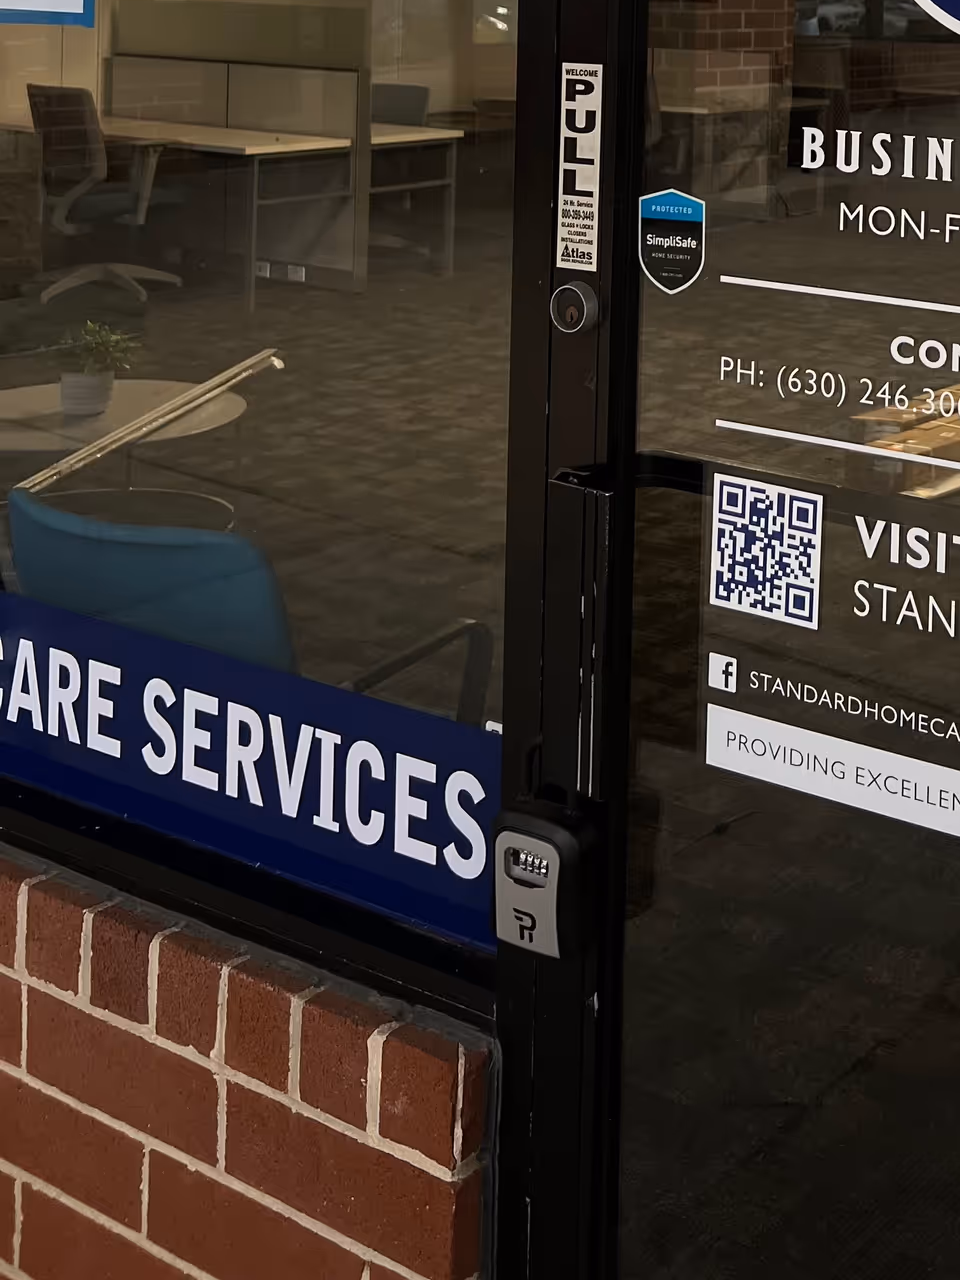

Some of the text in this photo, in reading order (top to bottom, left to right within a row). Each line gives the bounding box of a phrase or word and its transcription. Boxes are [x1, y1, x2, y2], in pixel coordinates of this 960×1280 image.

[565, 68, 599, 77] WELCOME
[562, 78, 596, 198] PULL
[652, 205, 693, 215] PROTECTED
[560, 237, 593, 245] INSTALLATIONS
[646, 233, 697, 248] SimpliSafe
[560, 243, 592, 260] Atlas
[720, 356, 765, 387] PH:
[777, 365, 847, 408] (630)
[0, 635, 486, 880] ARE SERVICES
[726, 730, 845, 779] PROVIDING
